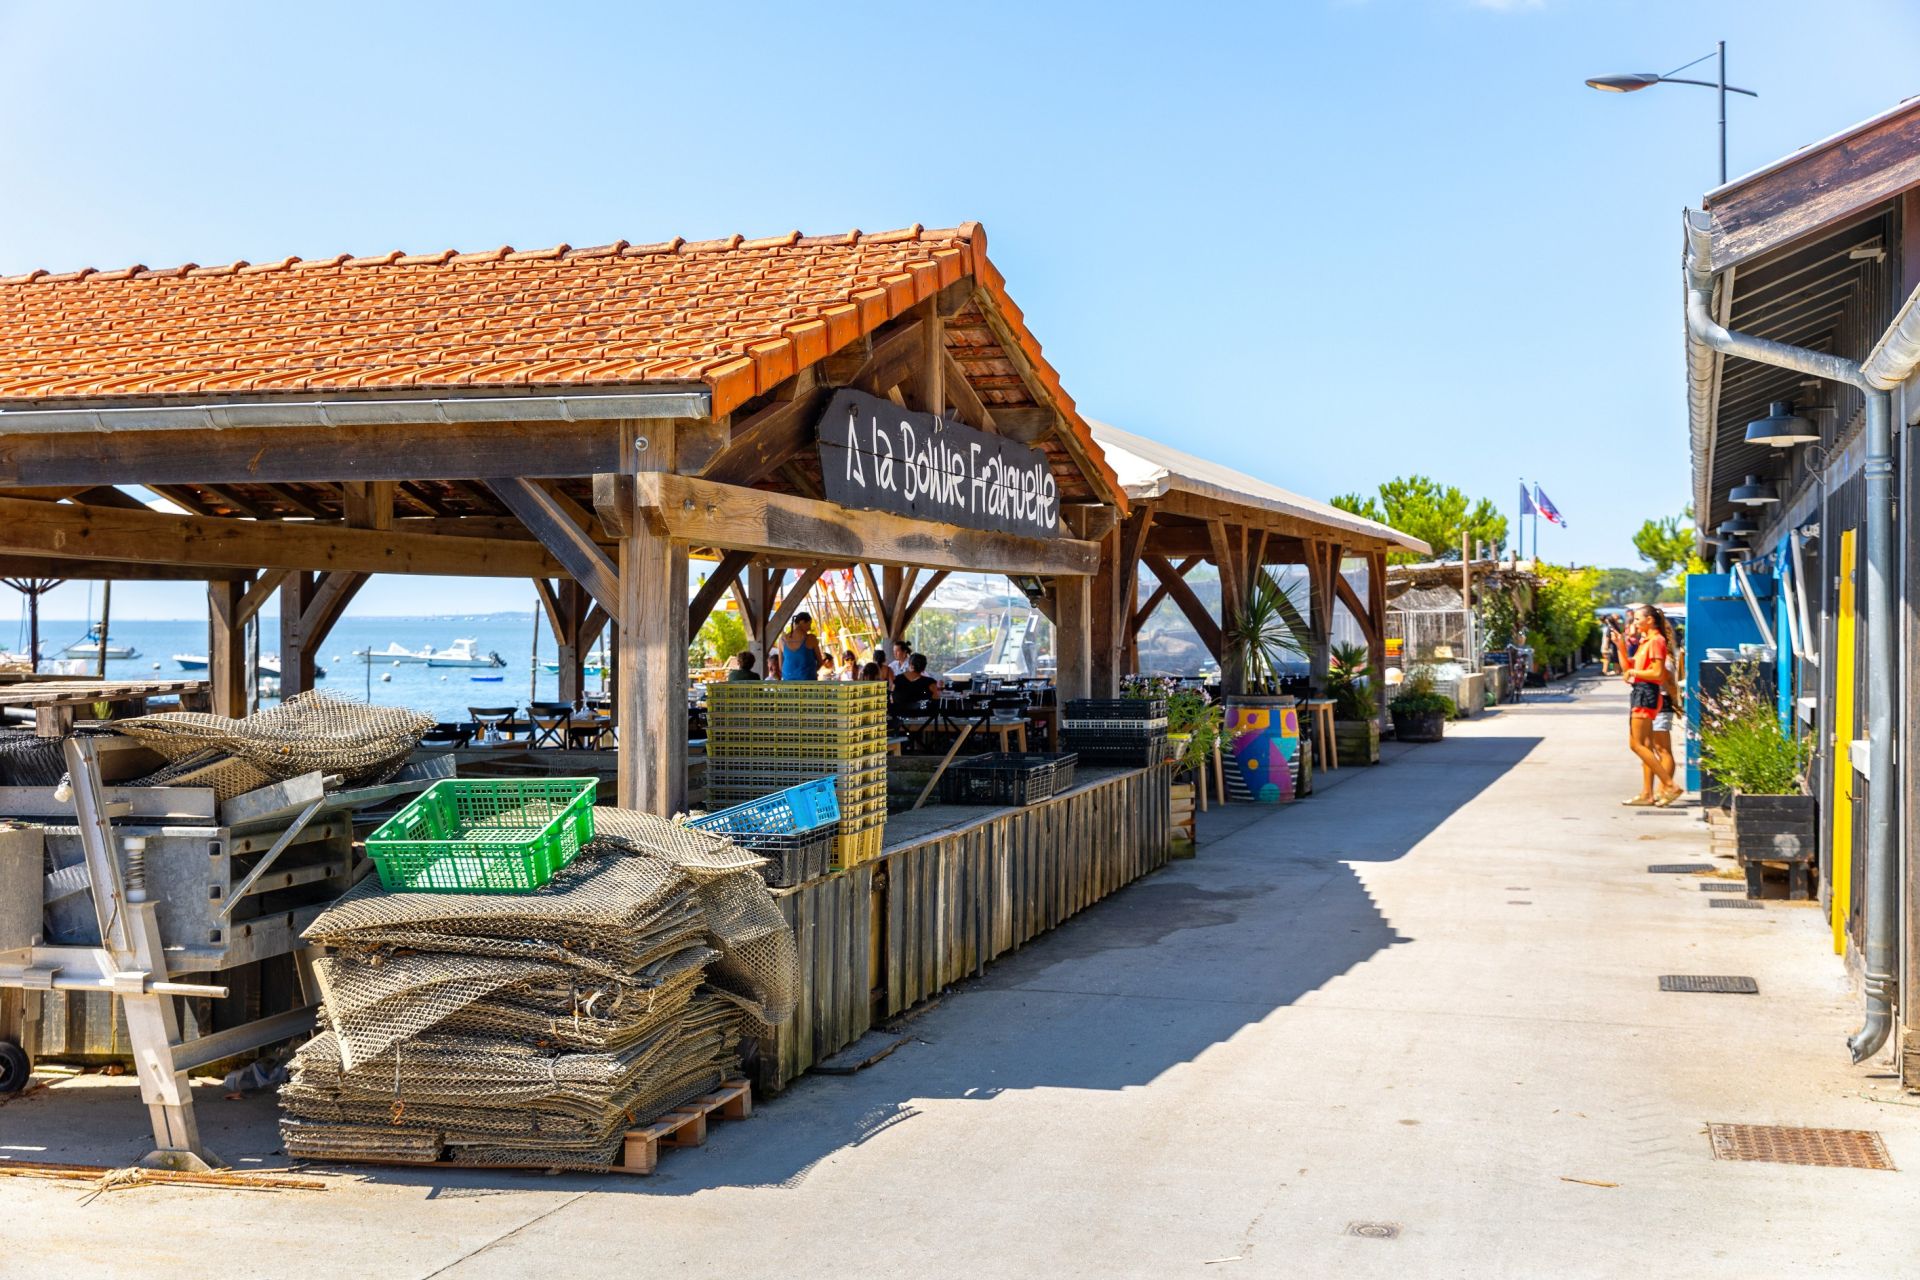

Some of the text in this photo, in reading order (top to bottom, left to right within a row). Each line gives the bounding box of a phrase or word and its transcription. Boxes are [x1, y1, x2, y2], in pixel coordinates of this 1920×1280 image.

[847, 414, 866, 488] A
[872, 416, 897, 492] la
[900, 421, 965, 509] Bonne
